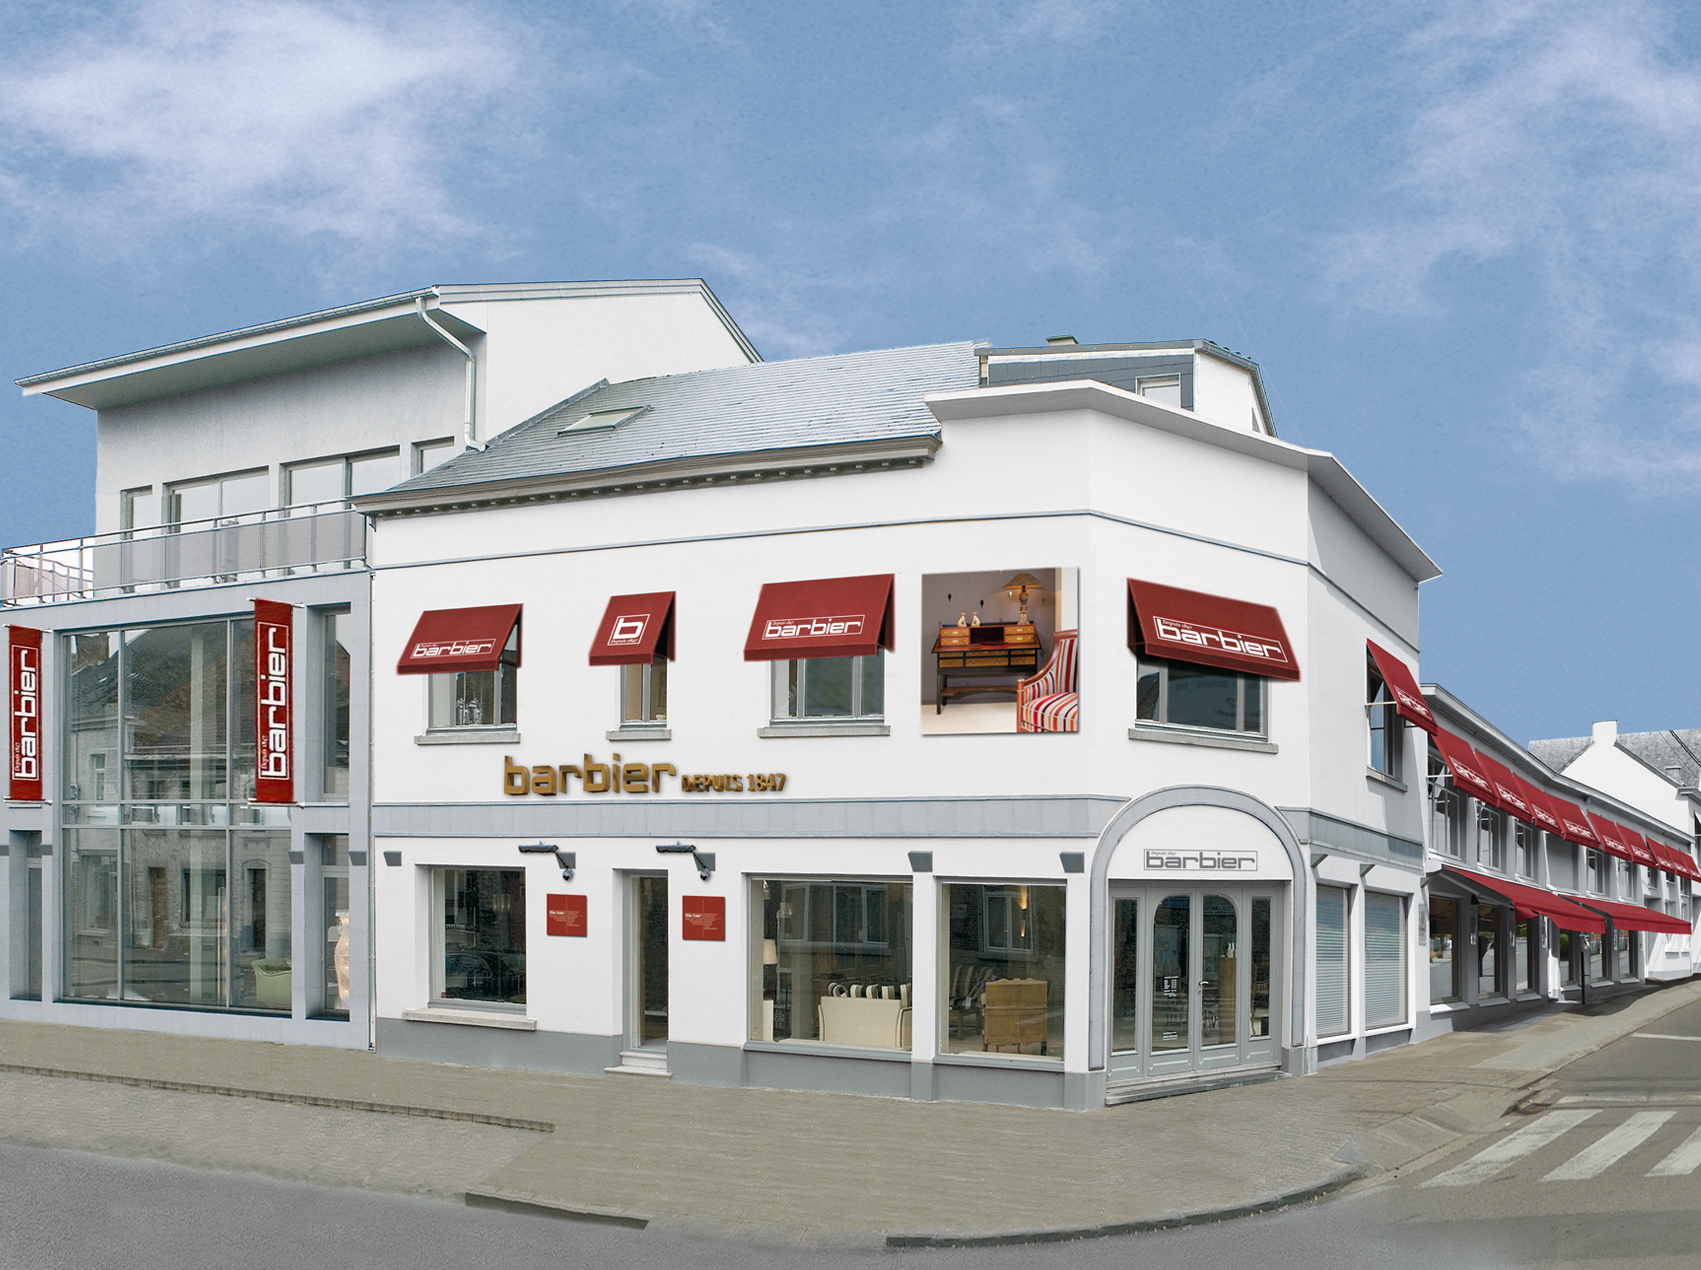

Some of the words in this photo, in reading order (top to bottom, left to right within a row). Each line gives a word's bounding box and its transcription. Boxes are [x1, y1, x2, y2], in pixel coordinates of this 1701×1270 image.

[612, 617, 644, 640] b
[764, 618, 862, 638] barbier
[1156, 618, 1282, 657] barbier
[412, 641, 492, 657] barbier
[15, 649, 36, 778] barbier
[261, 627, 287, 777] barbier
[504, 752, 678, 797] barbier
[681, 774, 744, 793] DEPUIS
[747, 772, 788, 793] 1847
[1146, 851, 1256, 869] barbier
